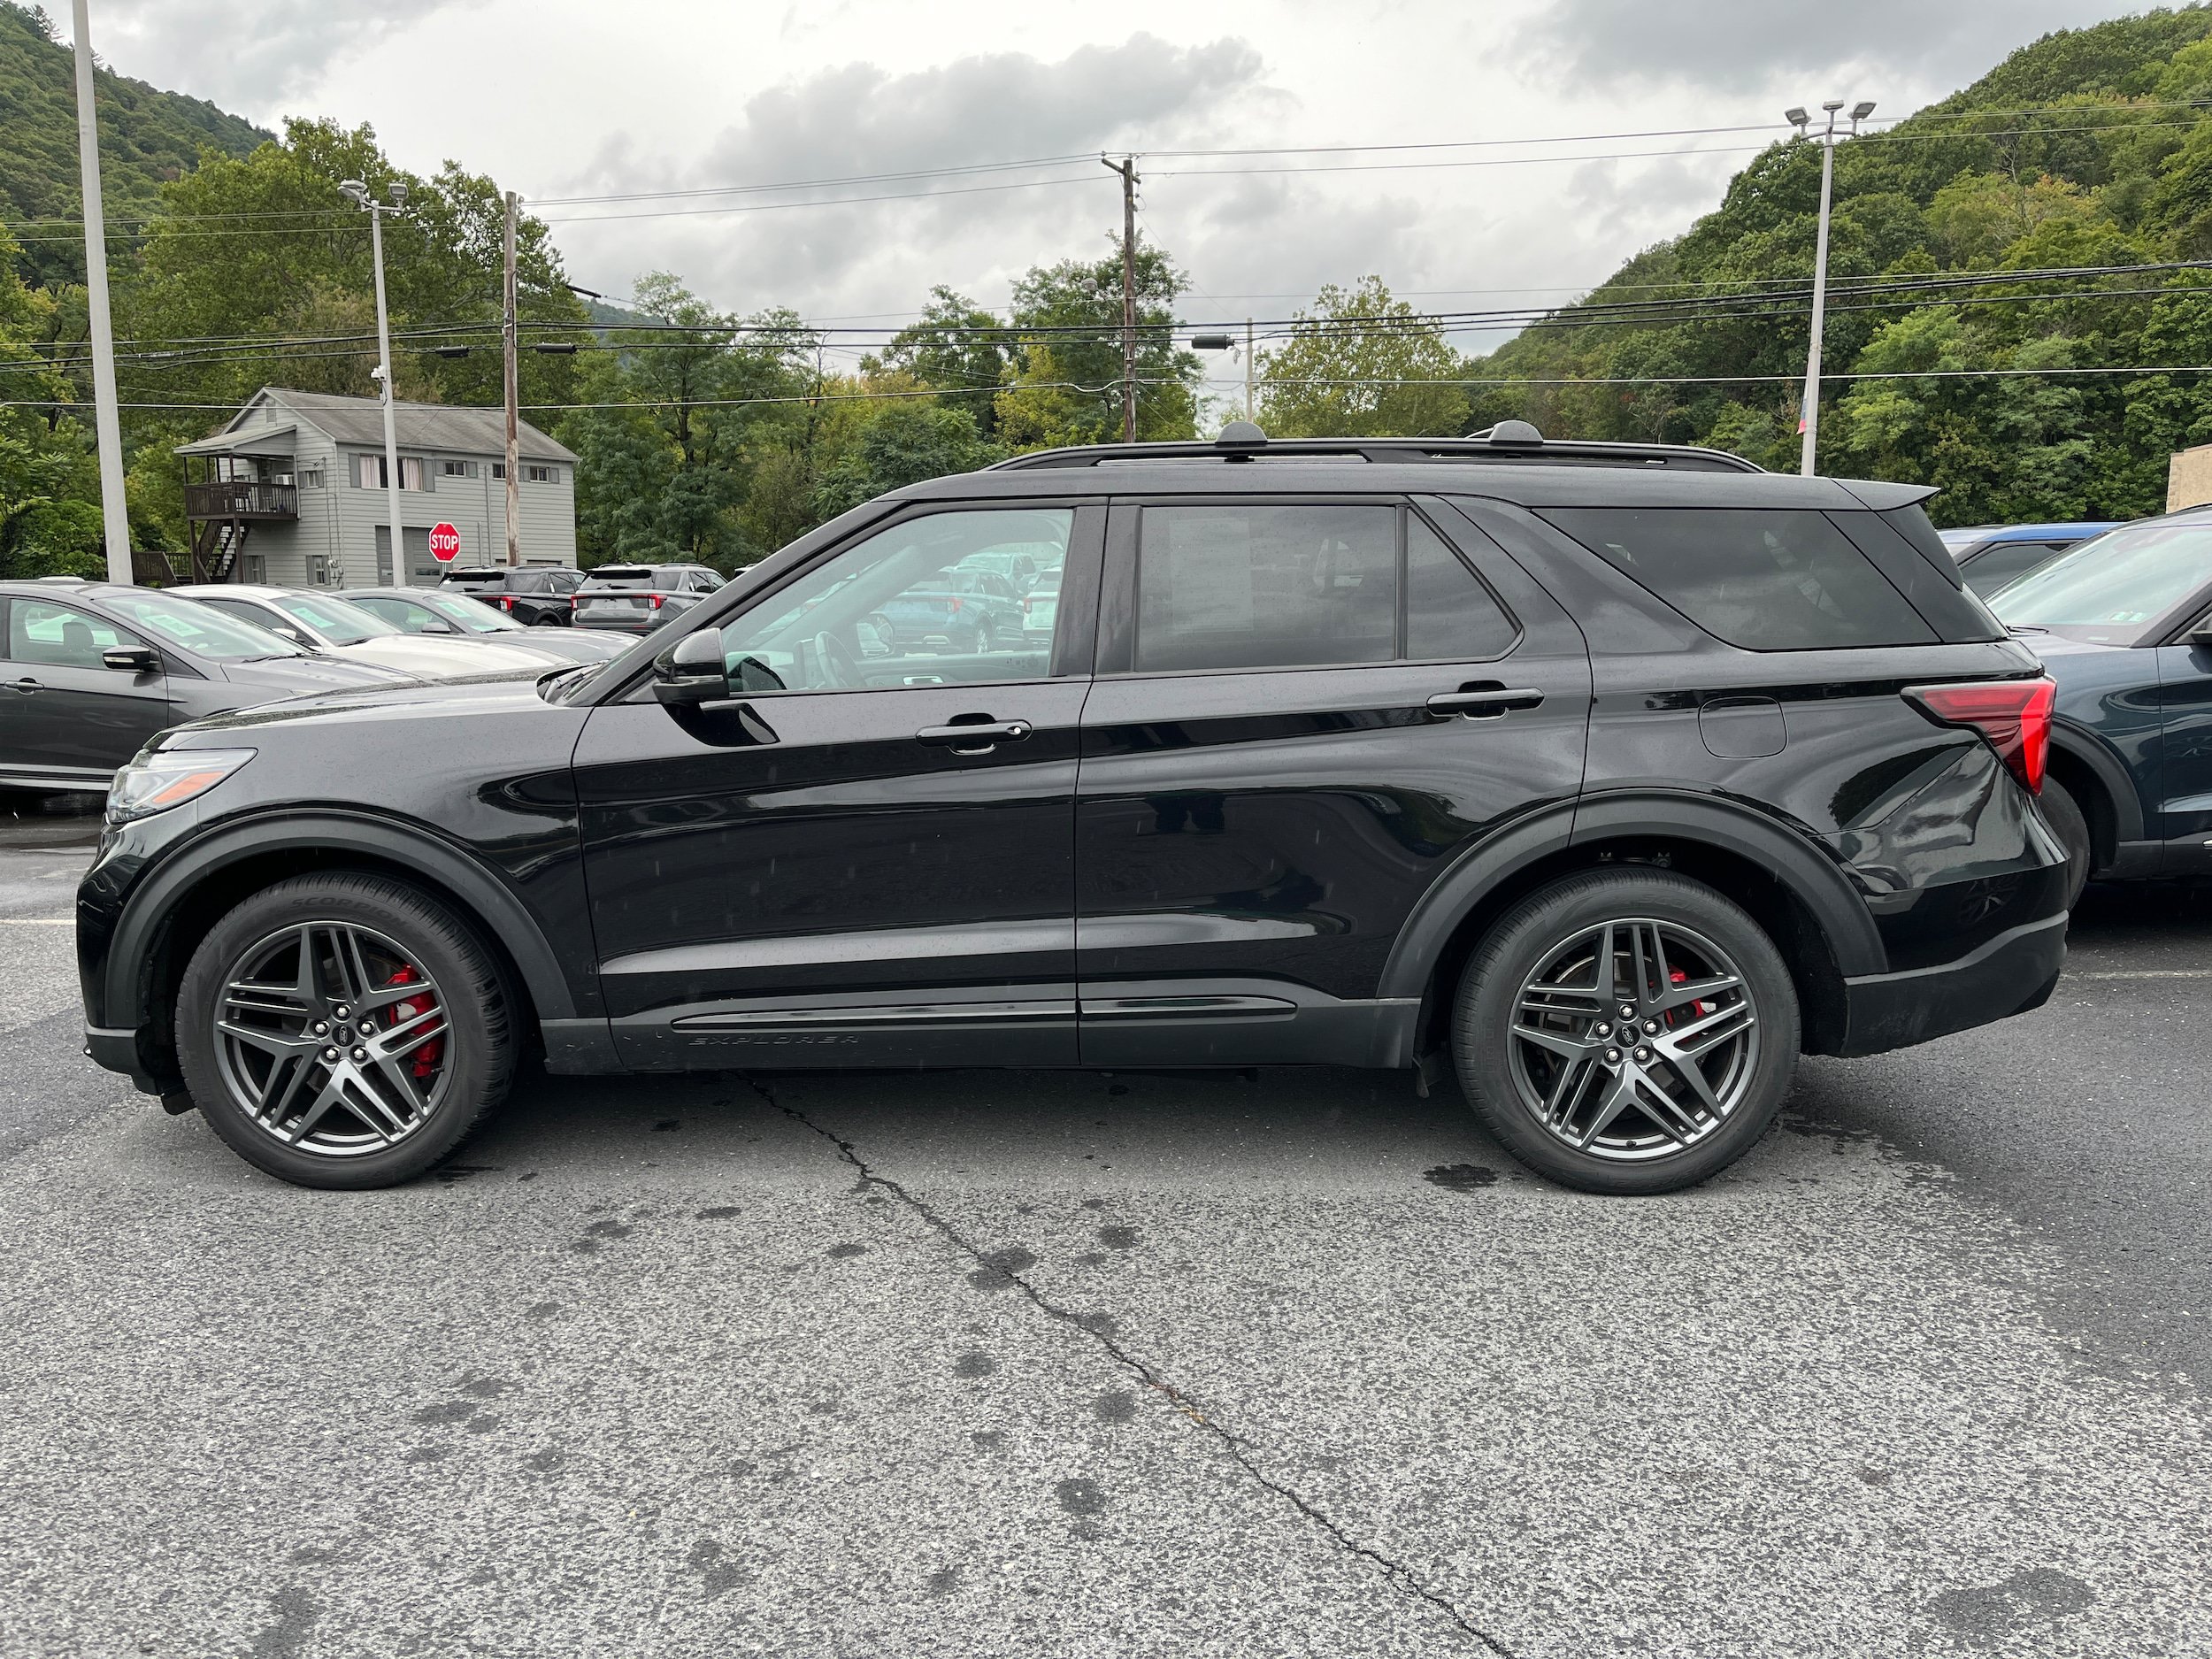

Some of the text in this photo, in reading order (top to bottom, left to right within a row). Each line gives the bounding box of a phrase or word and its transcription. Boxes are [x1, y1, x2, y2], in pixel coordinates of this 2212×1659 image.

[431, 534, 458, 550] STOP
[290, 896, 408, 928] SCORPION
[688, 1035, 860, 1046] EXPLORER
